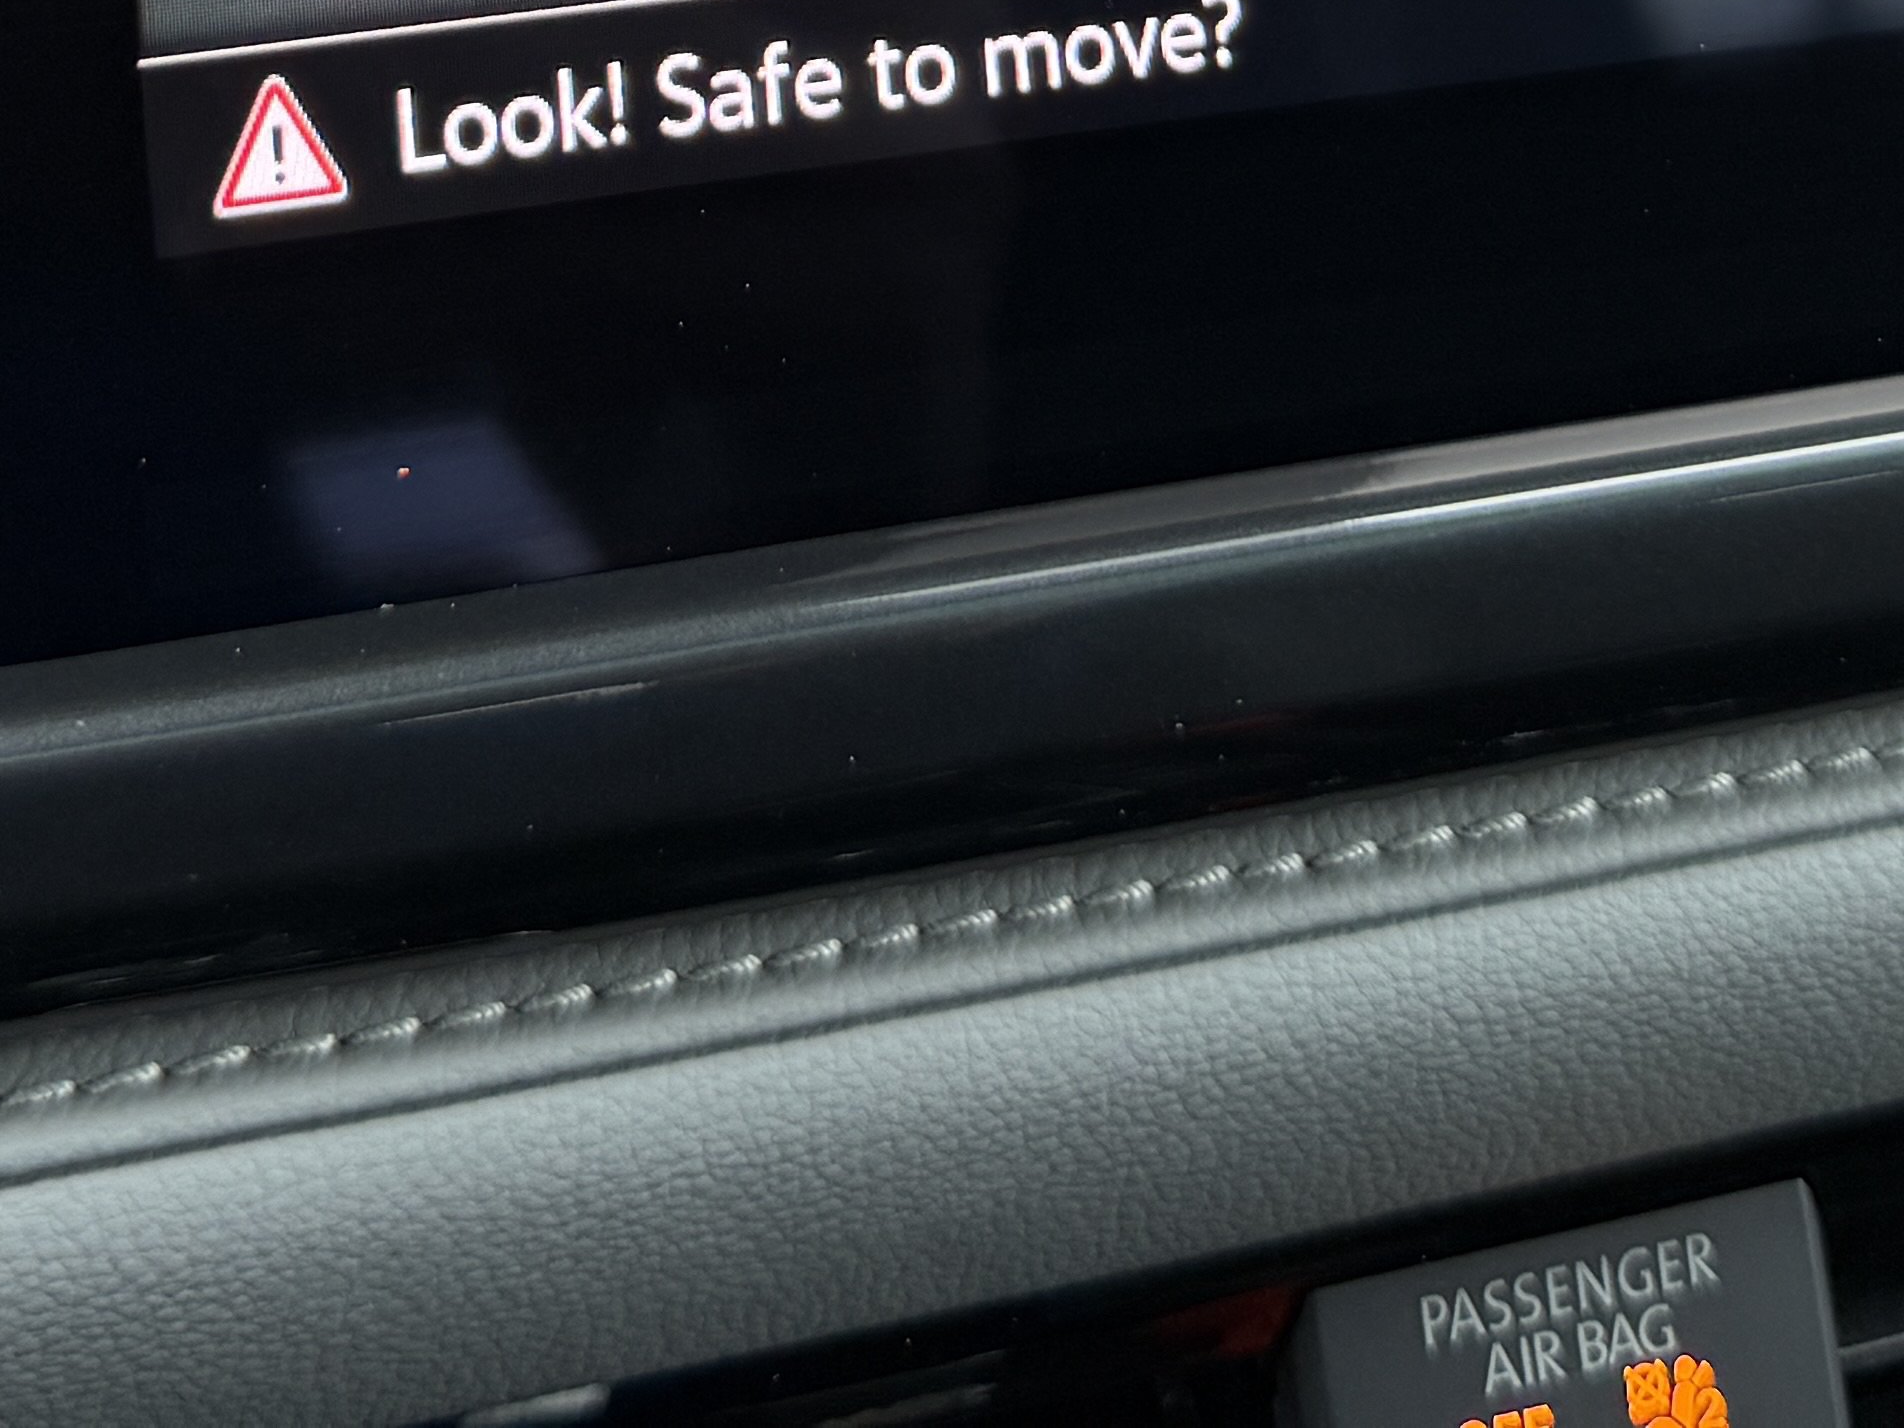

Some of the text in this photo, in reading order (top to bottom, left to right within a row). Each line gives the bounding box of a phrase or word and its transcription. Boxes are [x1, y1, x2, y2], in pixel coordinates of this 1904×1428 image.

[395, 61, 629, 176] Look!
[657, 39, 843, 138] Safe
[872, 38, 956, 112] to
[1420, 1232, 1723, 1347] PASSENGER
[1484, 1303, 1678, 1395] AIR BAG
